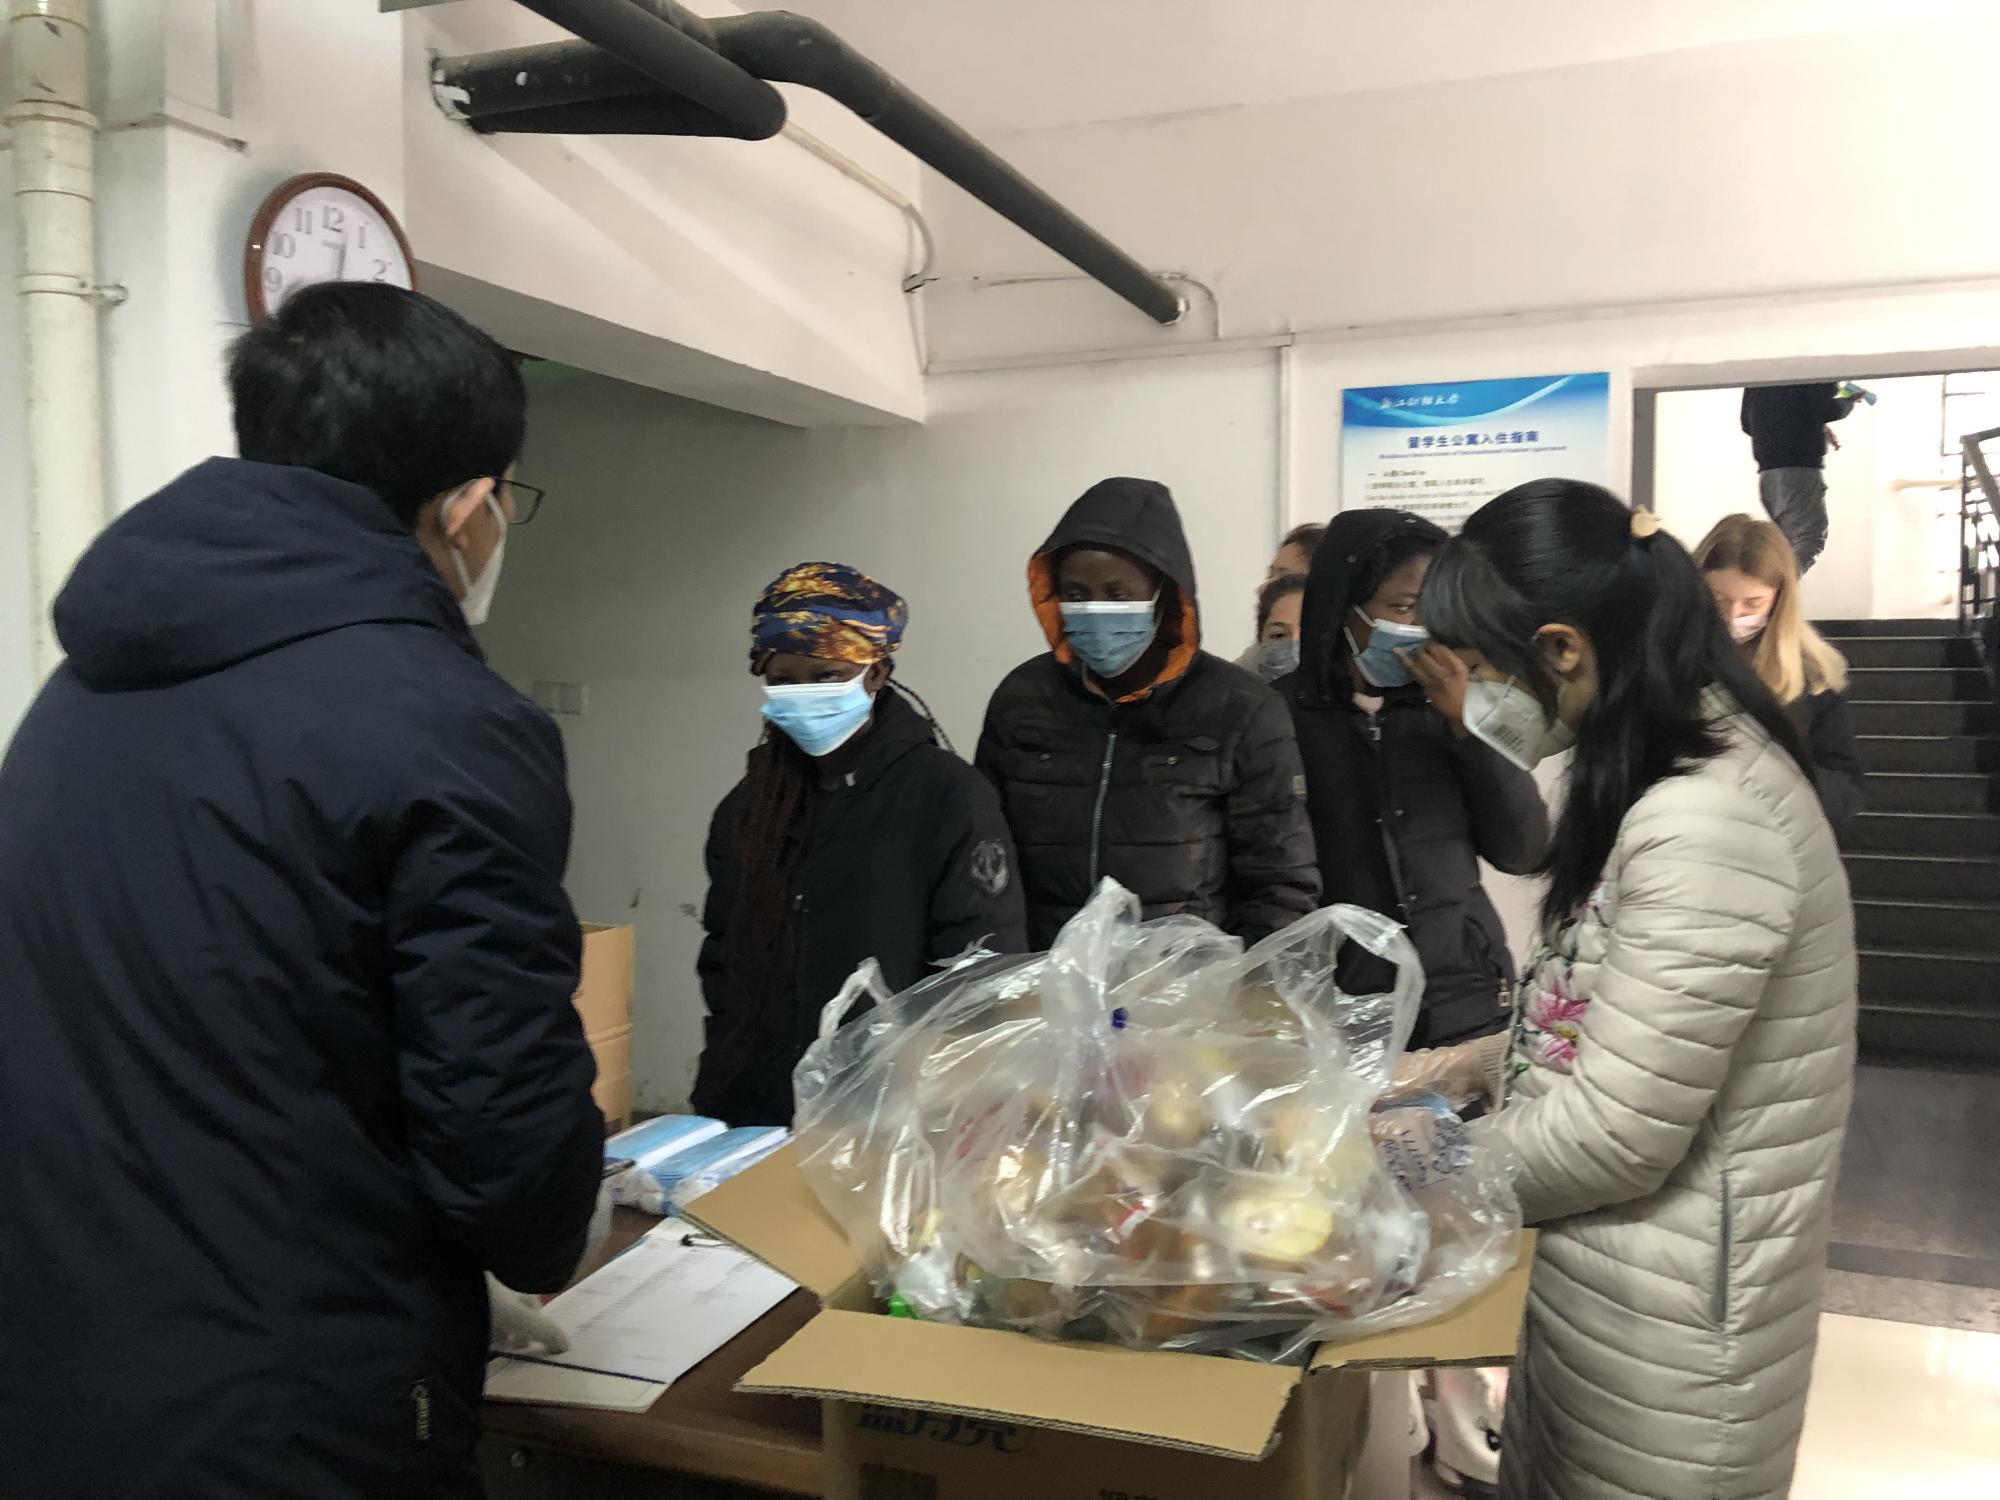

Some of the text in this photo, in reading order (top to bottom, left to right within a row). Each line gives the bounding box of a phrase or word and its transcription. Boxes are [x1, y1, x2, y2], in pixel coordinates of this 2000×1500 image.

[295, 207, 313, 235] 11
[321, 204, 345, 233] 12
[272, 231, 296, 259] 10
[358, 226, 366, 249] 1
[262, 266, 283, 293] 9
[372, 258, 388, 282] 2
[1408, 431, 1539, 449] 留学生公寓入住指南
